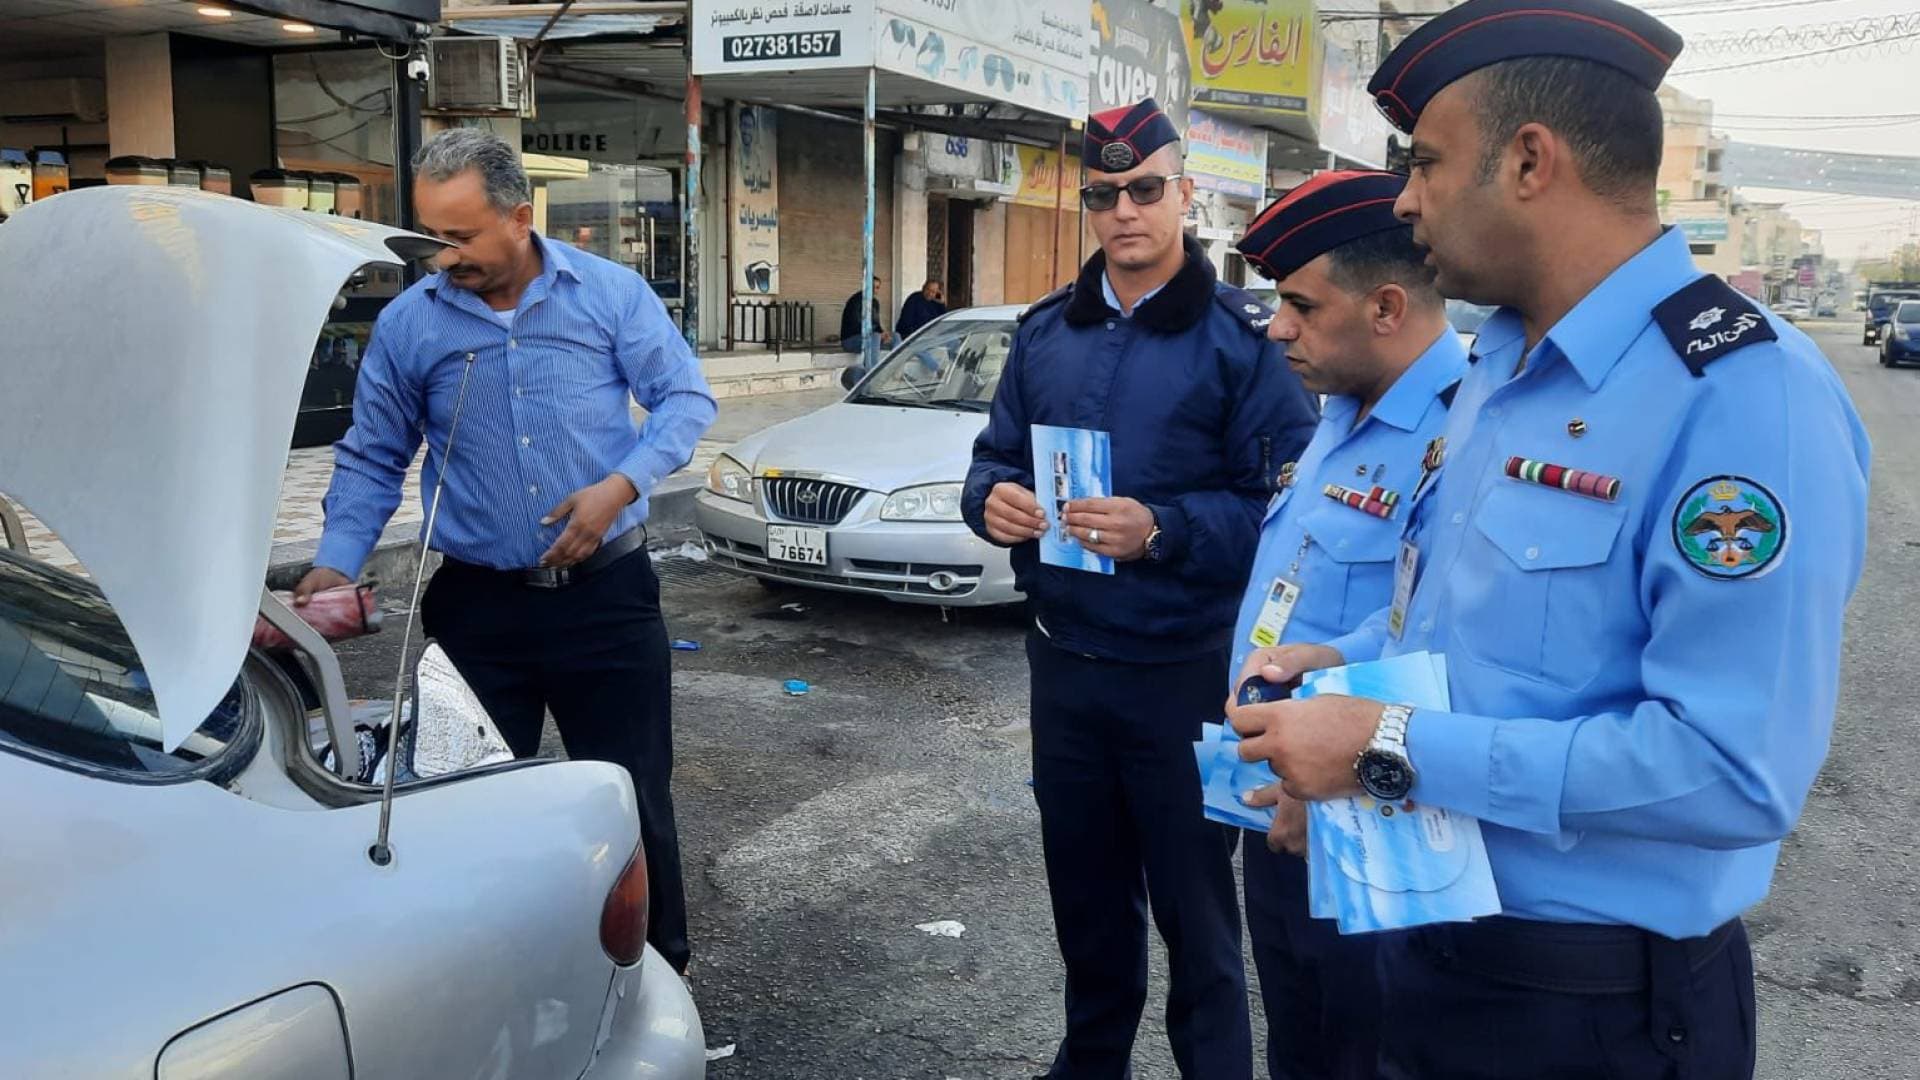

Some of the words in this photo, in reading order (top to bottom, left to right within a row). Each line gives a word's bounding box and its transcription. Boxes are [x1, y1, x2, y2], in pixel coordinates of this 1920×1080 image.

[732, 32, 836, 58] 027381557
[1201, 10, 1304, 79] الفارس
[521, 133, 607, 152] POLICE
[780, 545, 824, 563] 76674
